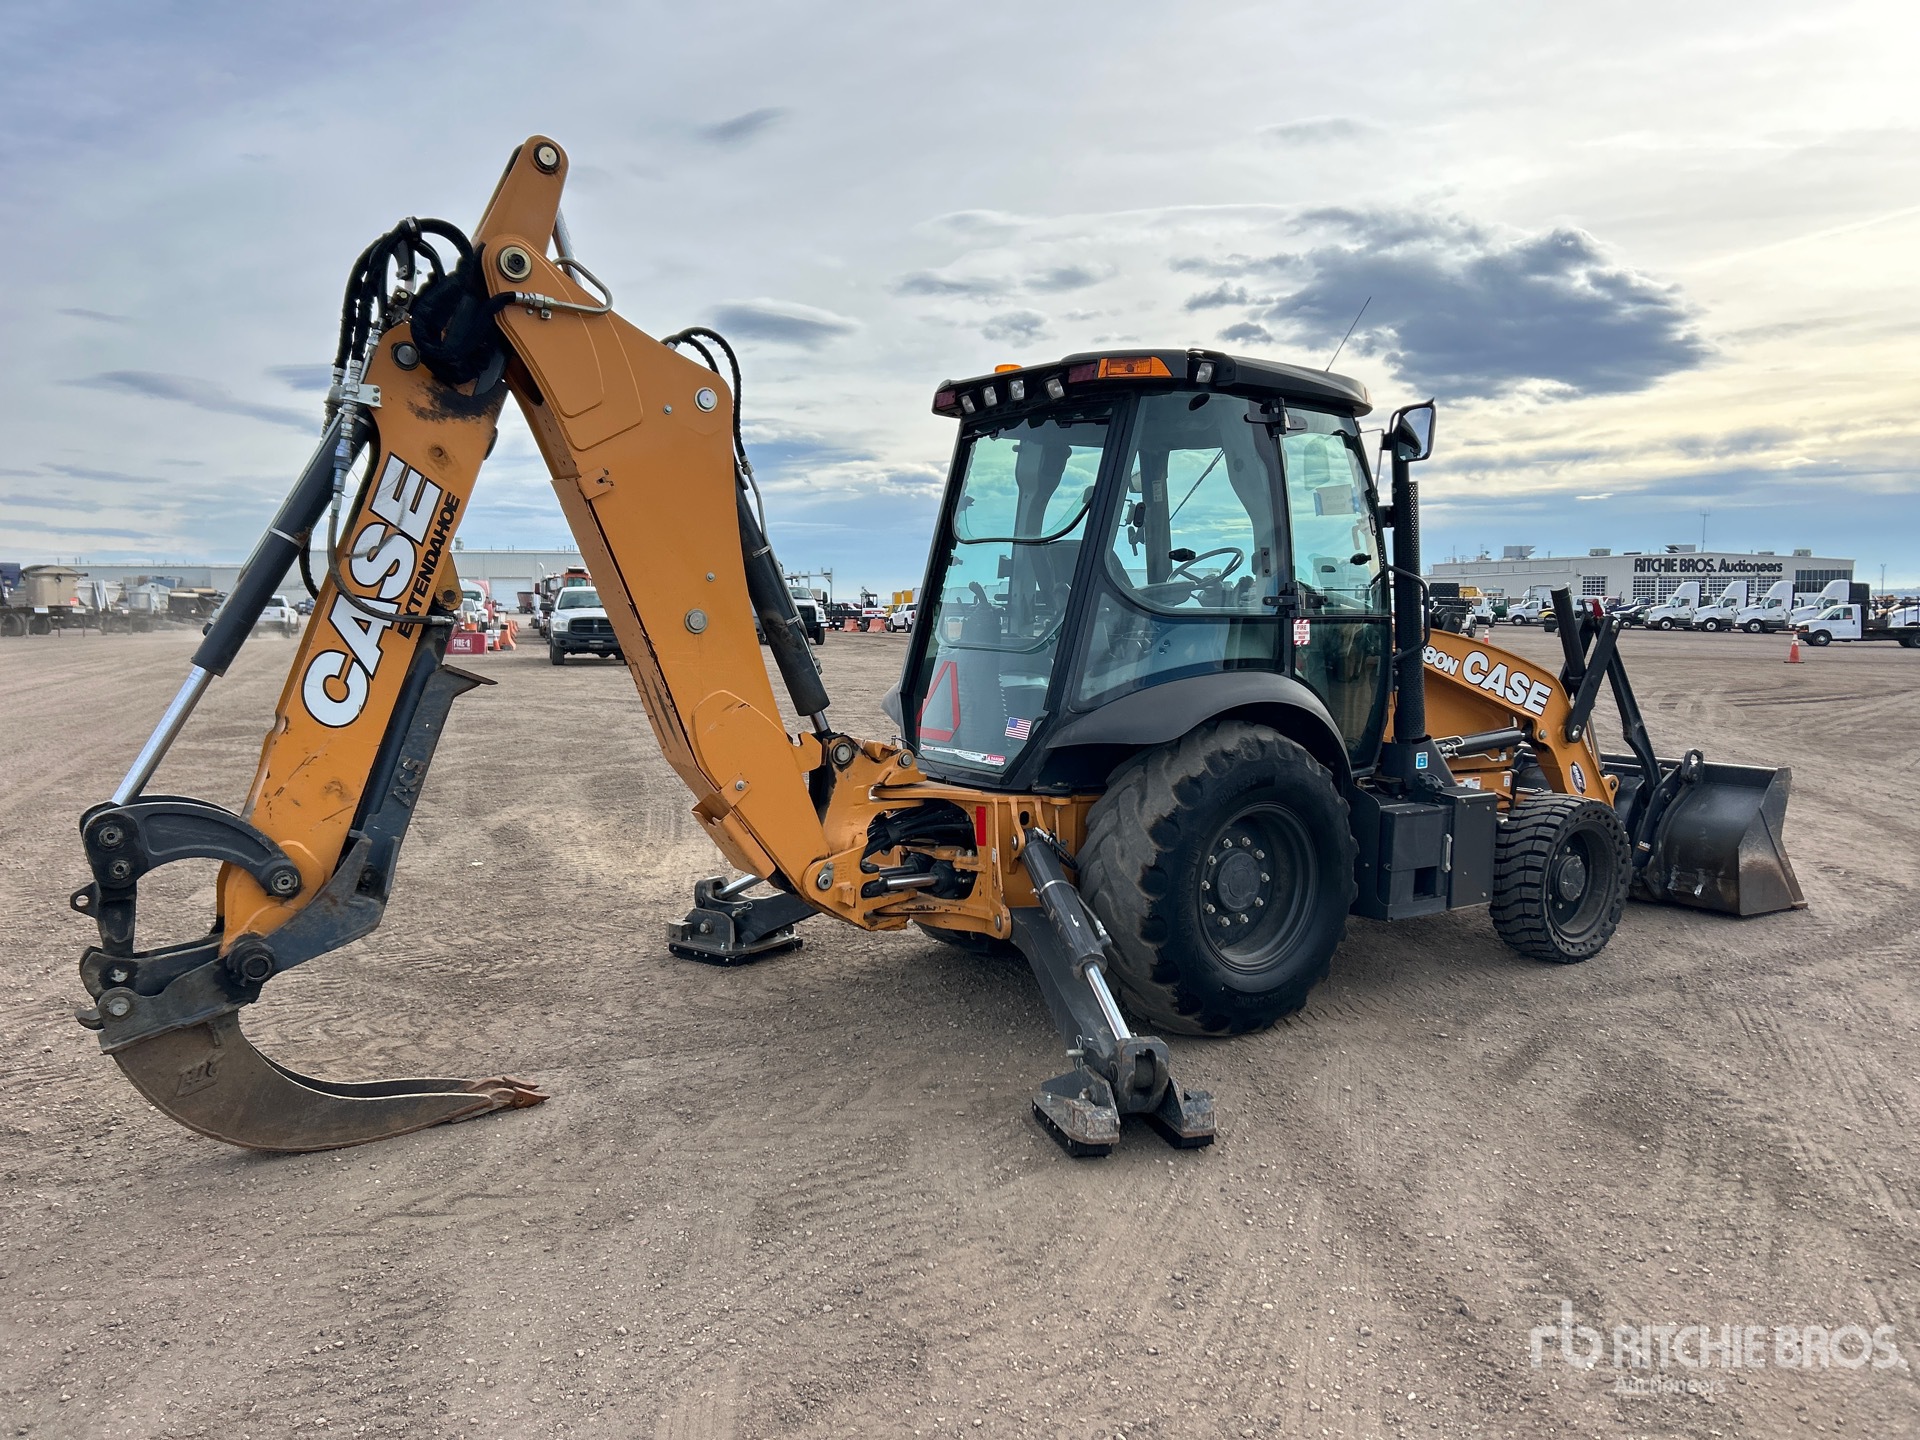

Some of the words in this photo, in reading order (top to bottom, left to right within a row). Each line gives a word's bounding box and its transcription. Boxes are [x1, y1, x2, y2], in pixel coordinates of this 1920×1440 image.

[302, 452, 443, 728] CASE
[1634, 558, 1677, 572] RITCHIE
[1680, 558, 1716, 572] BROS.
[1718, 558, 1783, 572] Auctioneers
[1422, 645, 1459, 676] 80N
[1462, 651, 1552, 716] CASE
